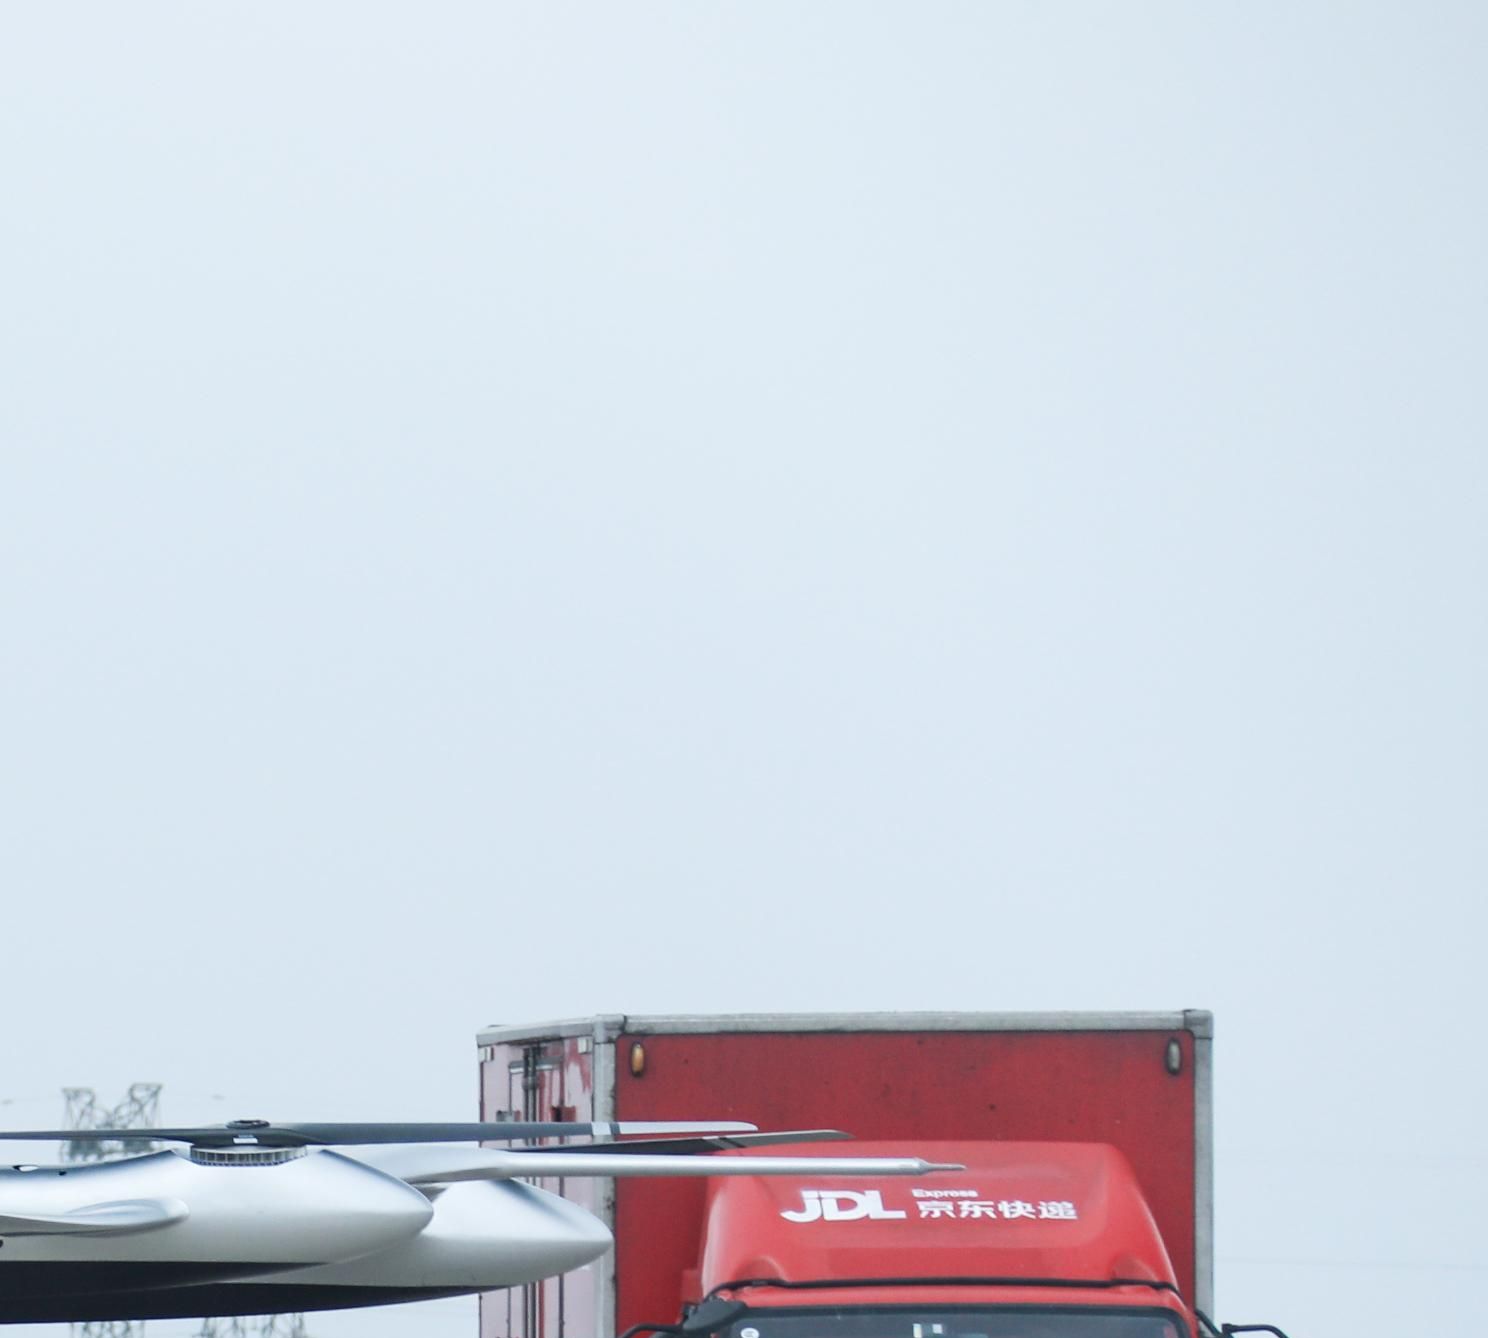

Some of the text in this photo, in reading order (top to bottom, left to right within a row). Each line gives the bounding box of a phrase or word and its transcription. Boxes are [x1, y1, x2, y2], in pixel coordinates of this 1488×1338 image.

[780, 1190, 1077, 1222] JDL 京东快递
